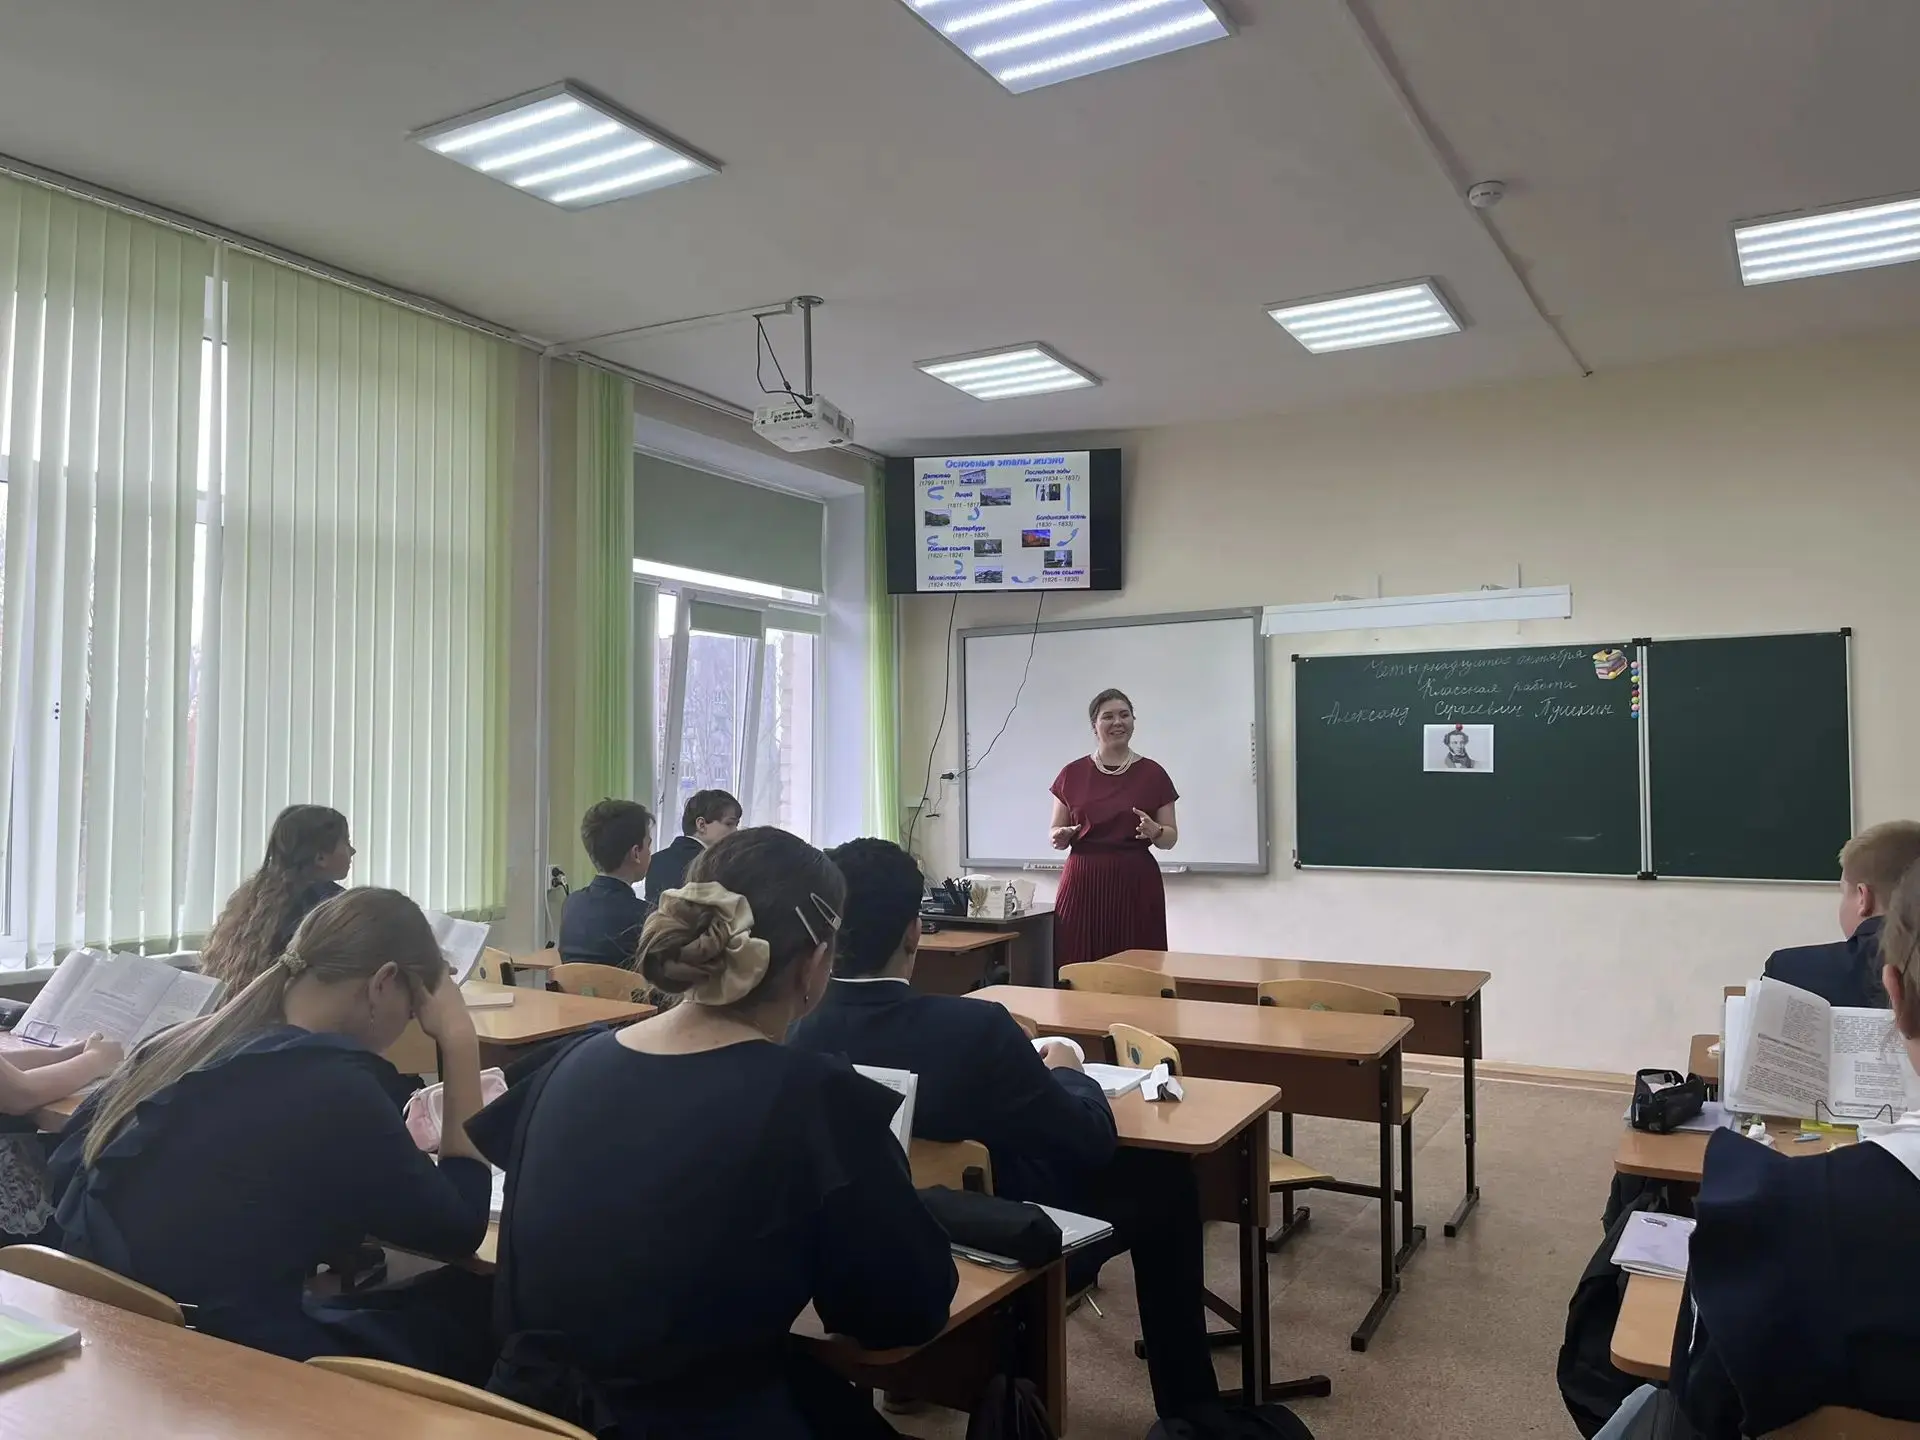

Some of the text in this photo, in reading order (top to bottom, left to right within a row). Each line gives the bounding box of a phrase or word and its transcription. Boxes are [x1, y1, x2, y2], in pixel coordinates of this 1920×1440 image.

[945, 457, 1064, 469] Основные этапы жизни
[1418, 678, 1577, 701] Классная работа
[1534, 697, 1615, 724] Пушкин
